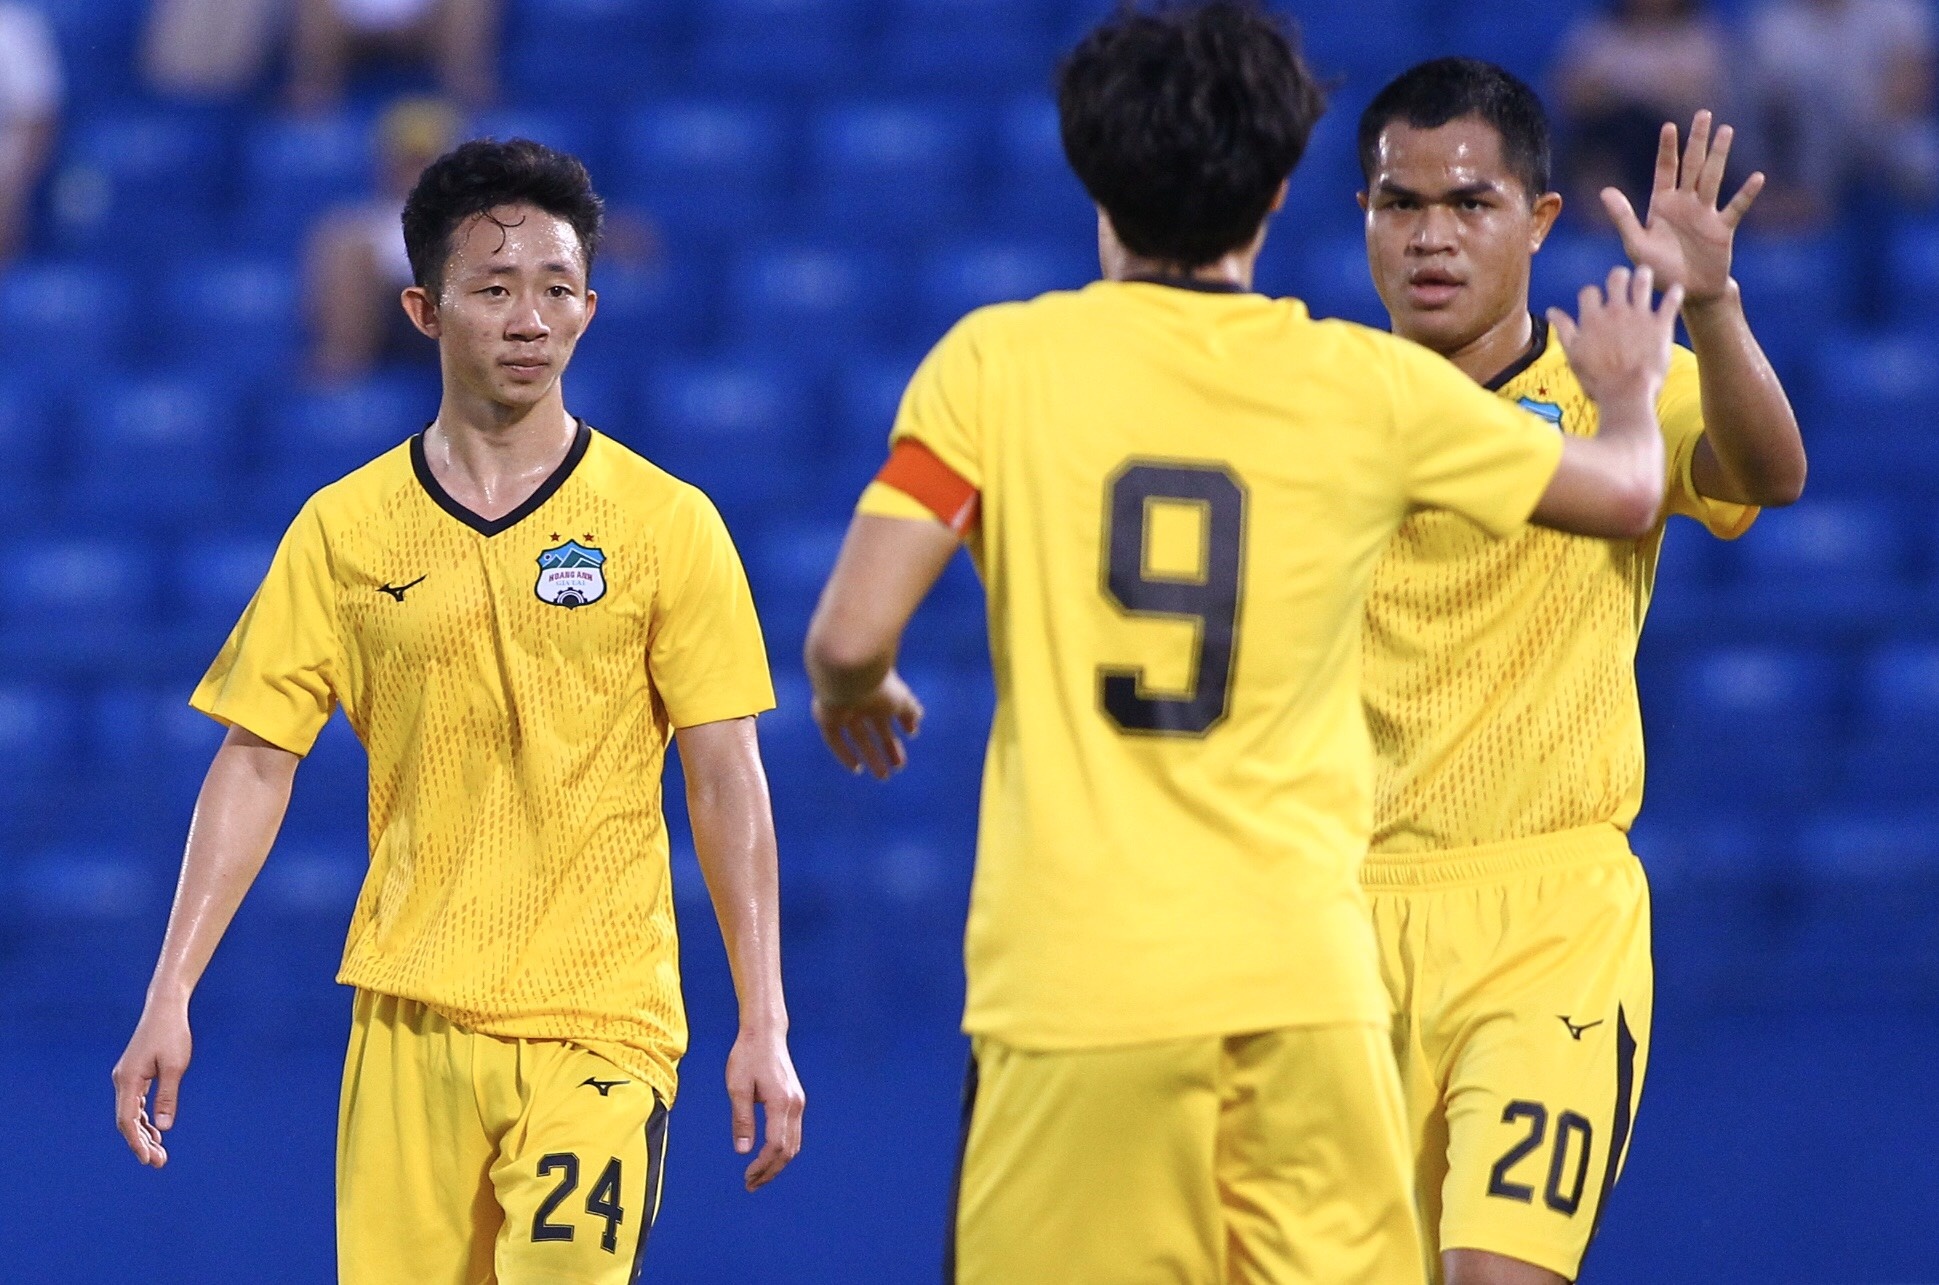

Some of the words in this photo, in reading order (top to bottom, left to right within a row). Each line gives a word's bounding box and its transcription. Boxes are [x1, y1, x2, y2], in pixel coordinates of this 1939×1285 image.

[548, 571, 575, 582] HOANG
[577, 571, 593, 582] ANH
[1095, 455, 1250, 739] 9
[531, 1152, 625, 1255] 24
[1486, 1099, 1593, 1219] 20
